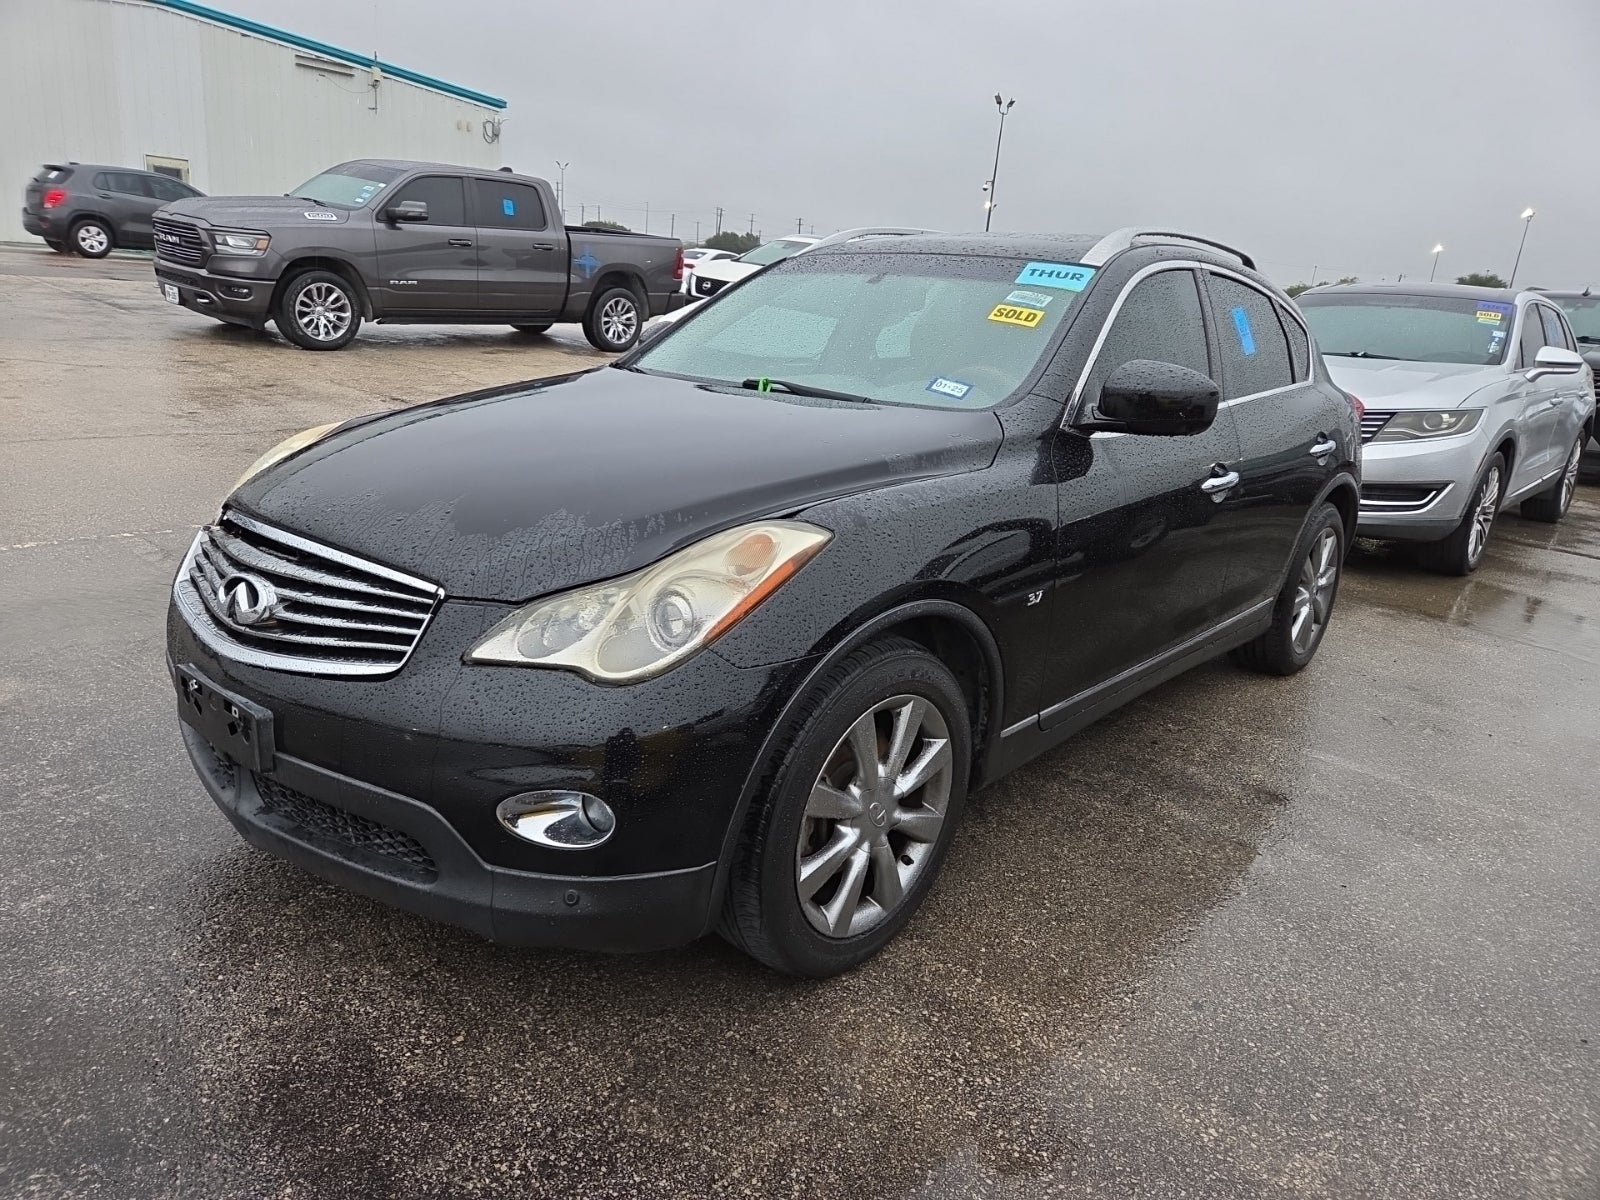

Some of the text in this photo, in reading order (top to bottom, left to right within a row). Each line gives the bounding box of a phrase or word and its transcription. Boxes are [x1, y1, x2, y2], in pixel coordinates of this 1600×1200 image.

[160, 232, 180, 244] RAM
[1029, 268, 1085, 281] THUR
[993, 307, 1038, 323] SOLD
